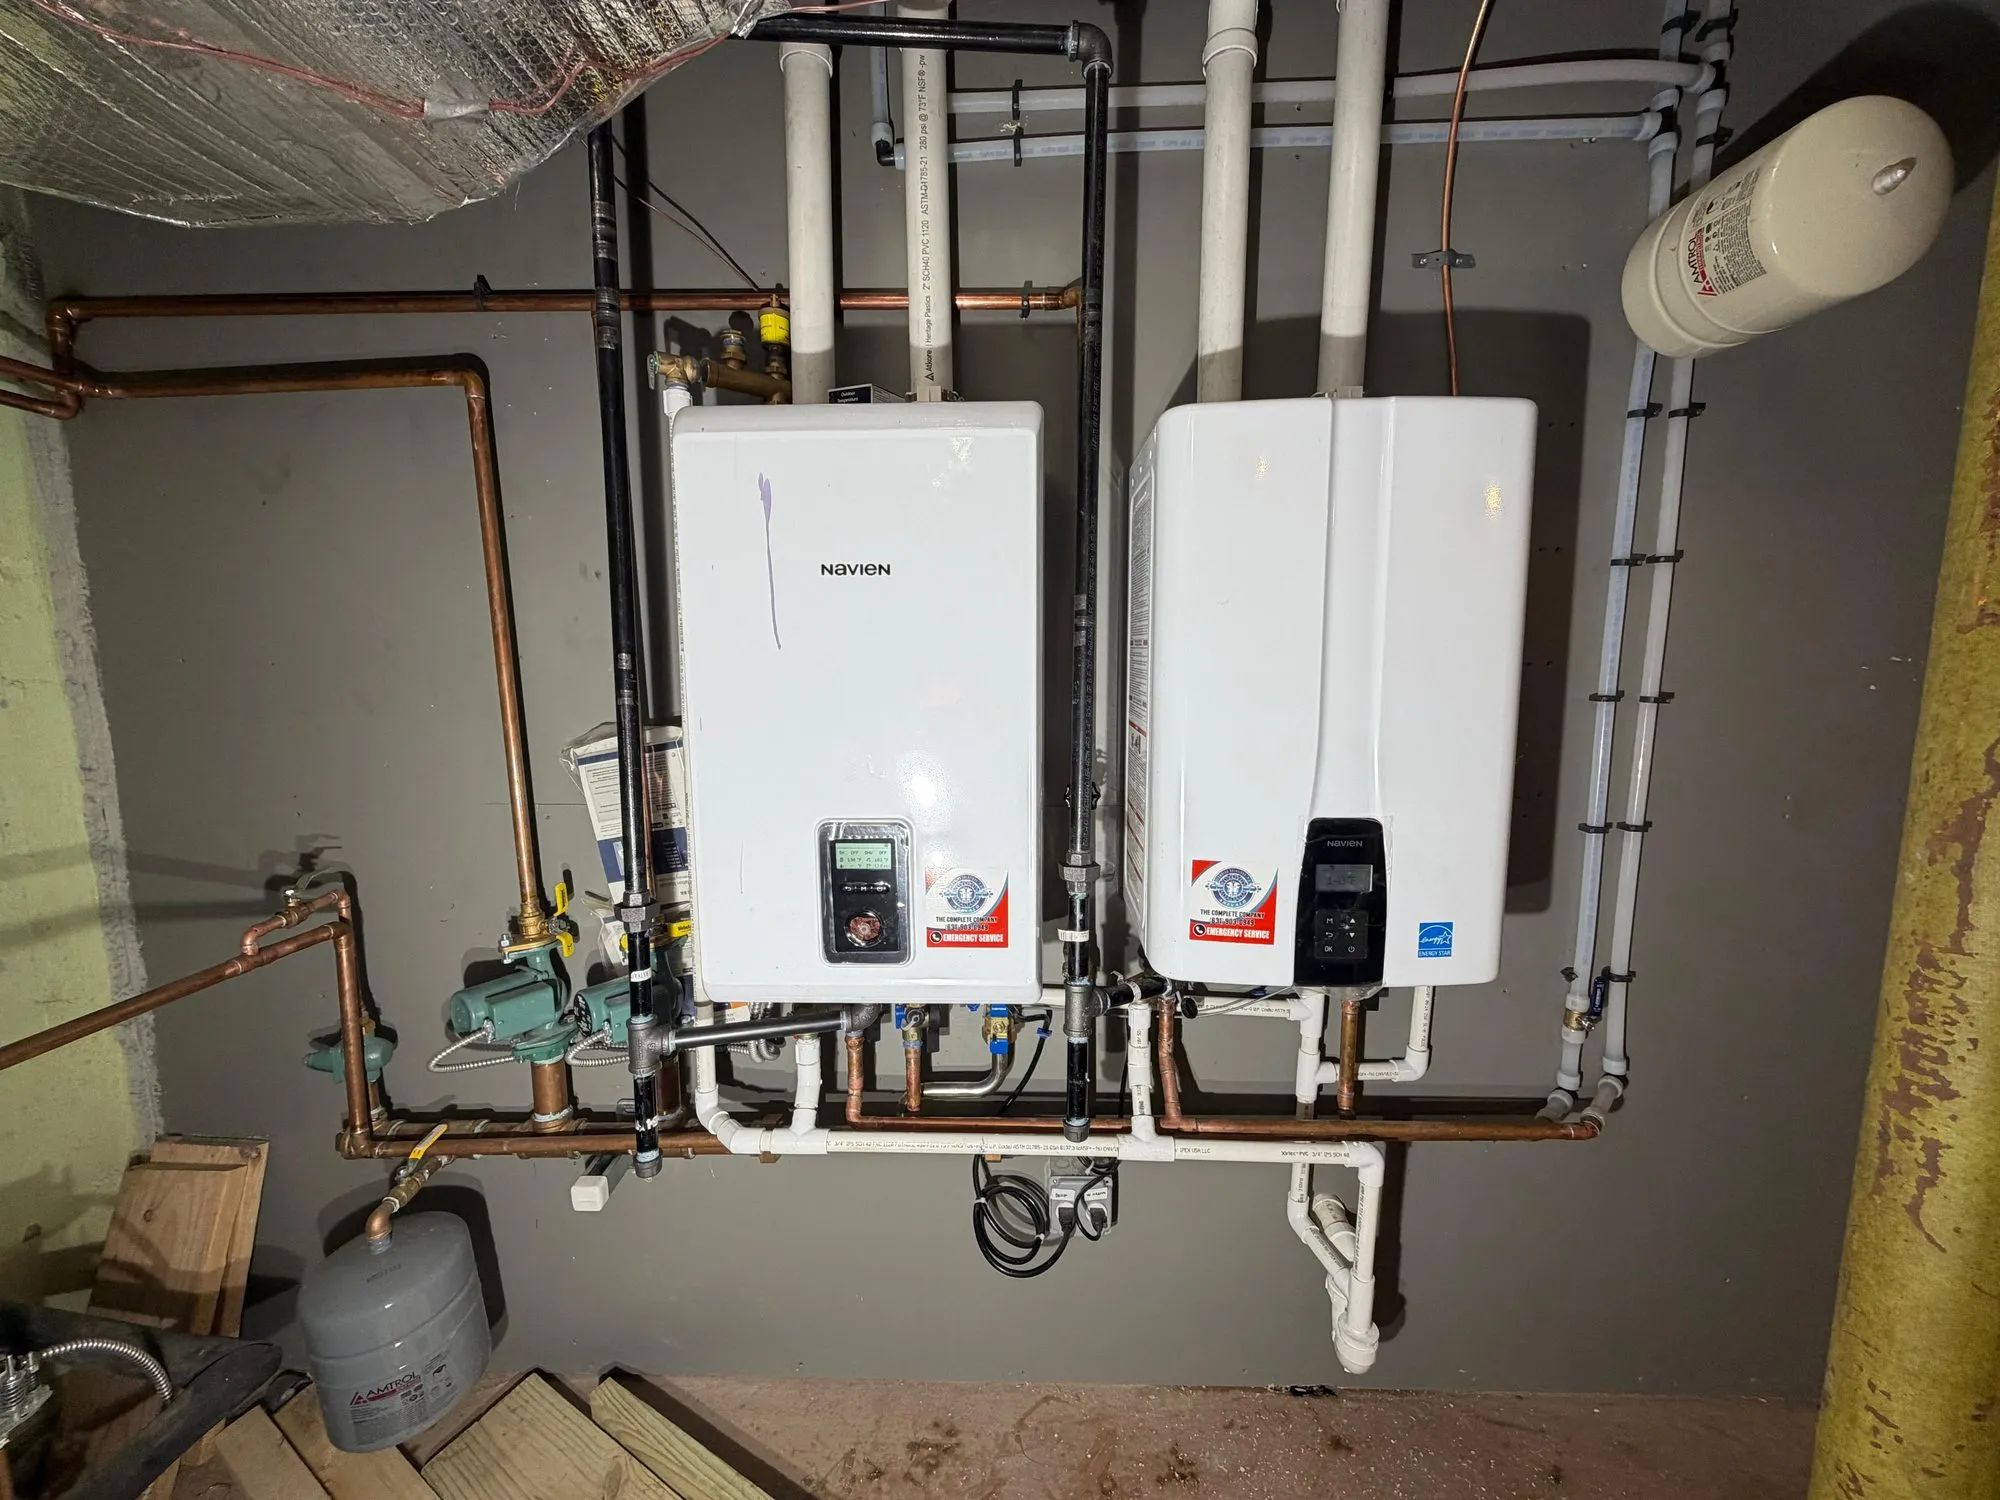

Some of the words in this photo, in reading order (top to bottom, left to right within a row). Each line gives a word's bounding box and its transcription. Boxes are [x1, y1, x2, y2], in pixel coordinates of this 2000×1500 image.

[919, 113, 928, 122] @
[920, 124, 929, 135] psi
[919, 135, 928, 150] 280
[921, 220, 930, 238] 1120
[921, 239, 930, 256] PVC
[922, 256, 931, 281] SCH40
[1687, 237, 1703, 284] AMTROL
[925, 350, 933, 372] Atkore
[1211, 910, 1238, 918] COMPLETE
[943, 934, 978, 942] EMERGENCY
[979, 934, 1004, 942] SERVICE
[1206, 928, 1243, 937] EMERGENCY
[1244, 930, 1270, 939] SERVICE
[366, 1372, 416, 1397] AMTROL
